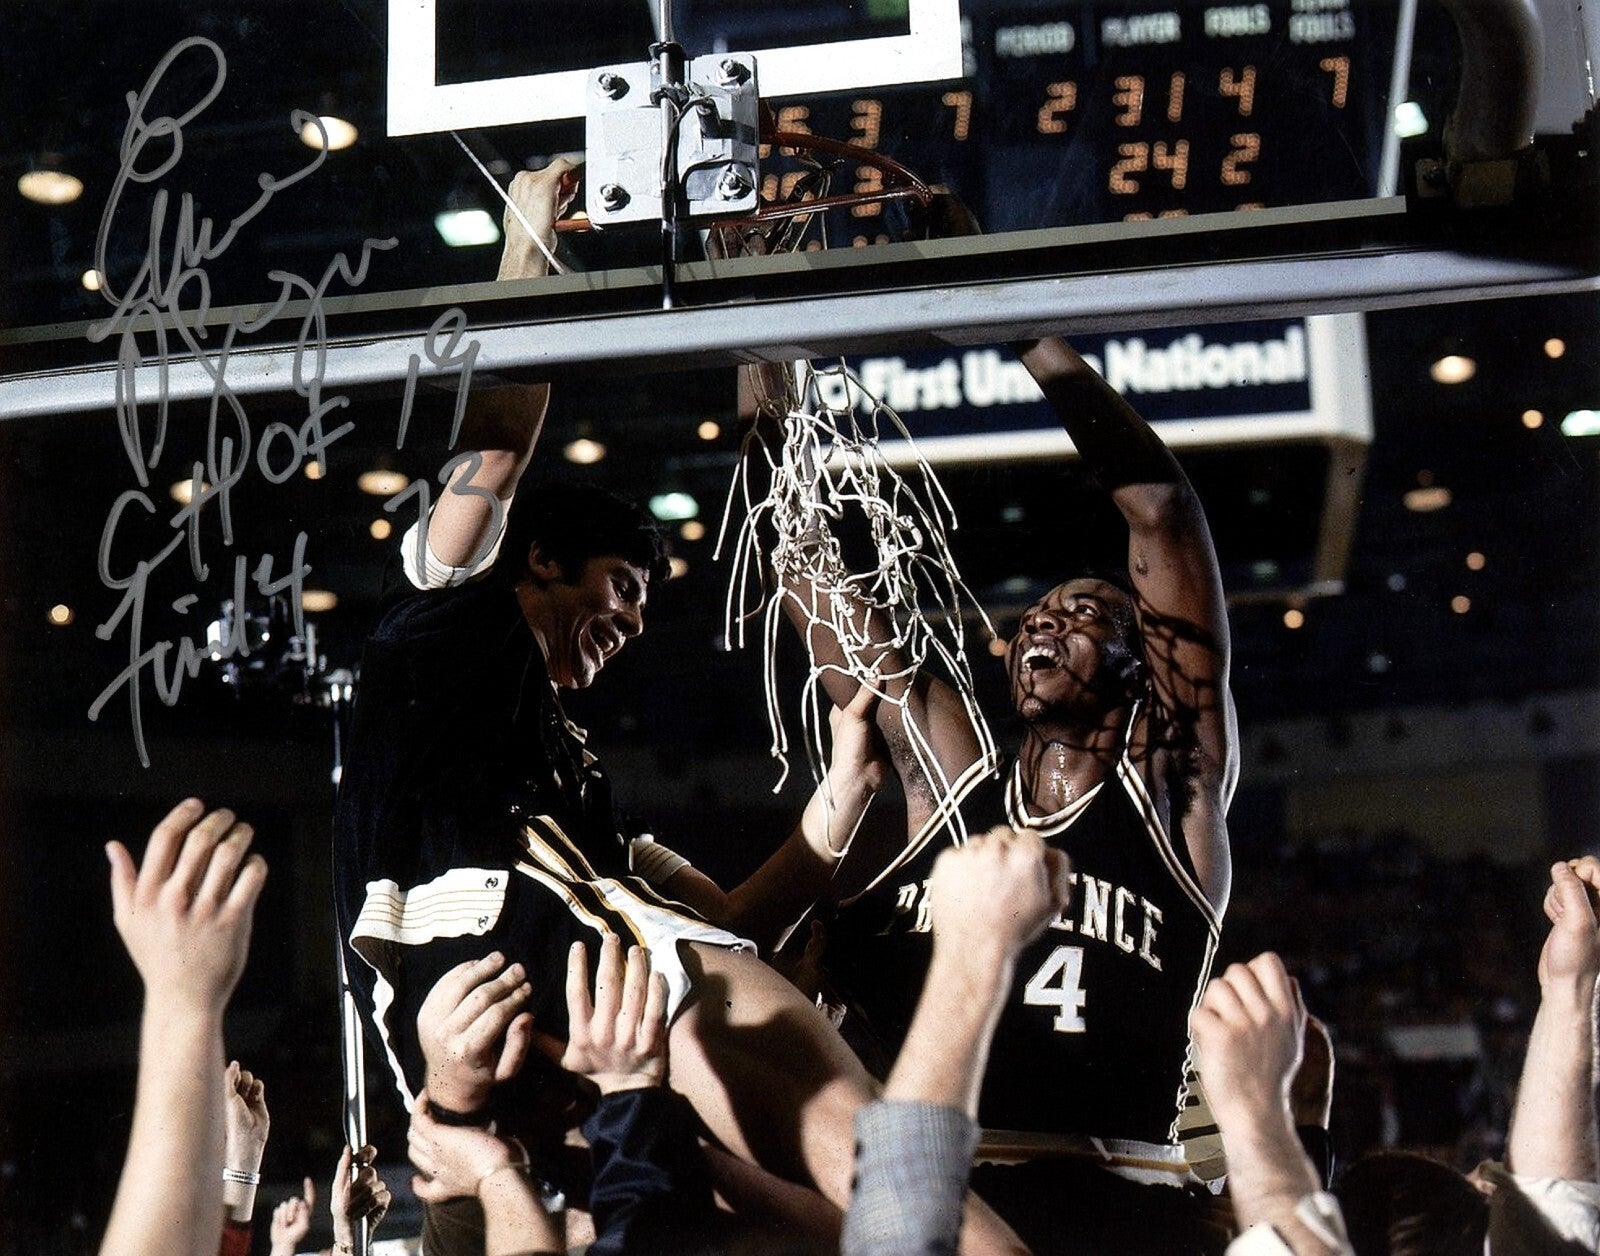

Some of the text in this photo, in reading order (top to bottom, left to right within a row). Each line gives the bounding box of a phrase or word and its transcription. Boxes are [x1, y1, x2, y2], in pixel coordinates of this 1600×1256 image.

[941, 90, 973, 141] 7
[1037, 80, 1078, 134] 2
[1112, 70, 1185, 127] 31
[1219, 64, 1257, 116] 4
[1320, 56, 1350, 108] 7
[1108, 138, 1190, 195] 24
[1220, 132, 1261, 186] 2
[859, 357, 963, 415] First
[1105, 326, 1304, 395] National
[1023, 945, 1087, 1033] 4
